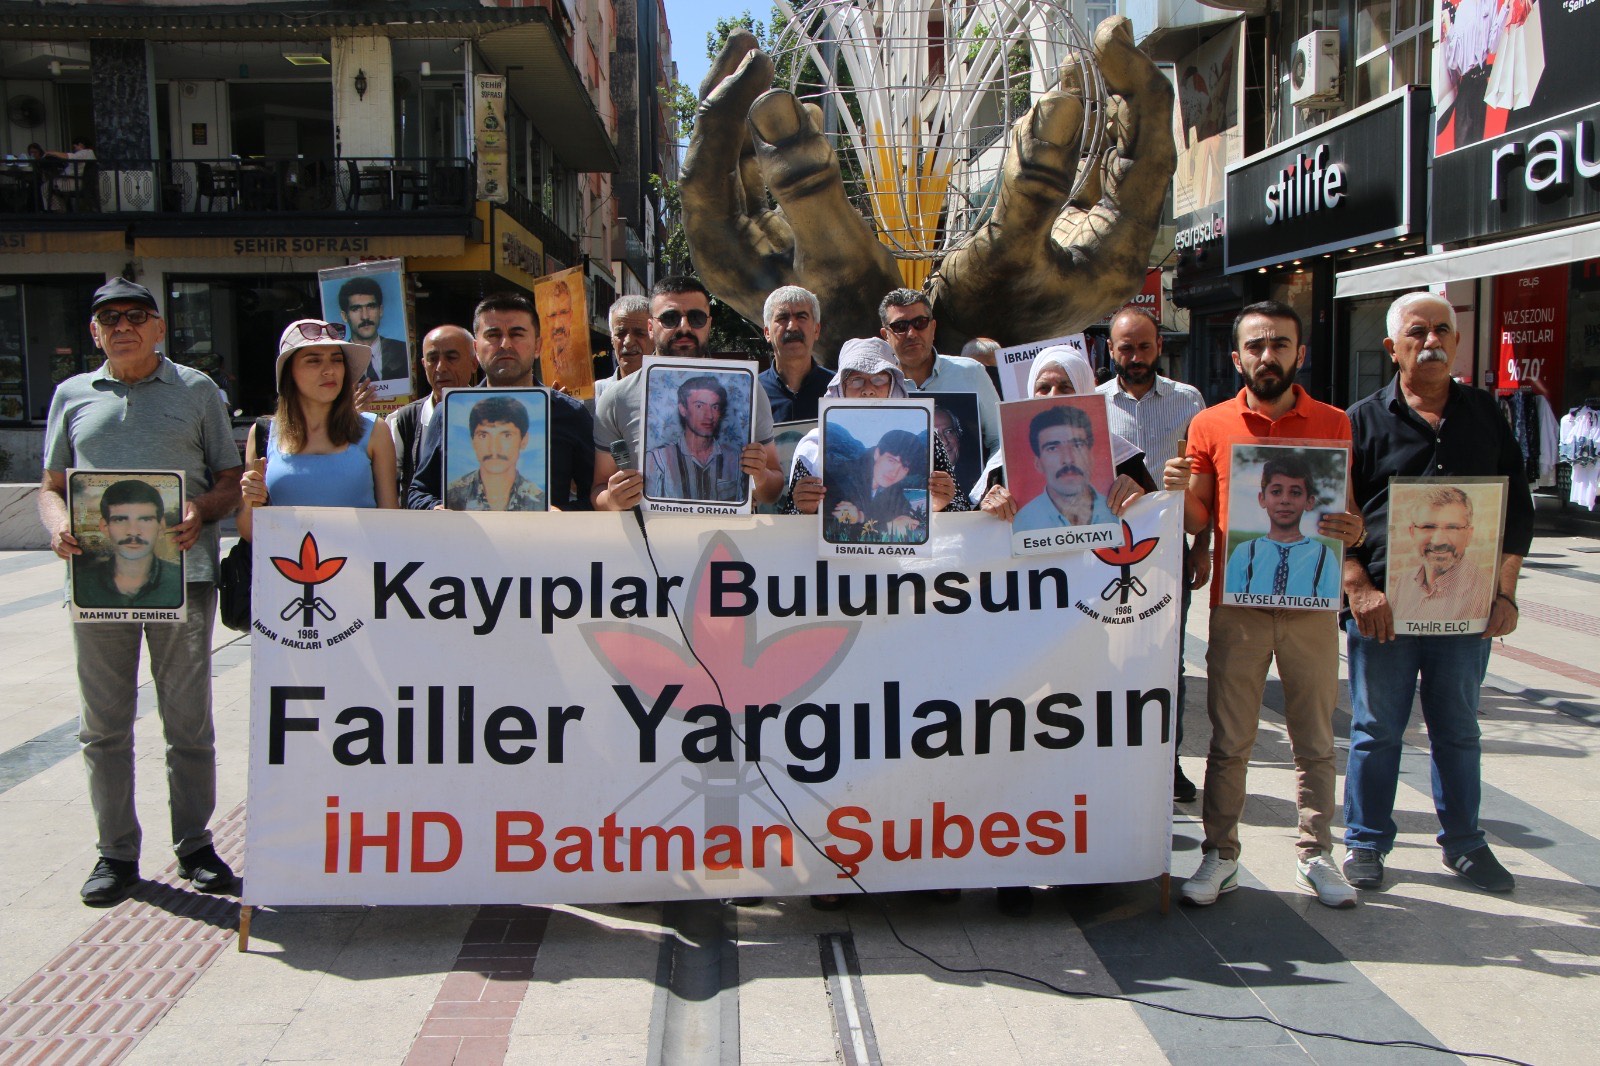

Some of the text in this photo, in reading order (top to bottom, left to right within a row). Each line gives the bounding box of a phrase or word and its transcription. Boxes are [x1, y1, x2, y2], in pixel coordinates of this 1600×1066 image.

[480, 81, 502, 90] ŞEHİR
[481, 91, 503, 99] SOFRASI
[1265, 144, 1342, 226] stilife
[233, 238, 369, 255] ŞEHİR SOFRASI
[1518, 276, 1540, 288] rays
[1503, 308, 1555, 325] YAZ SEZONU
[1502, 329, 1554, 345] FIRSATLARI
[1004, 346, 1047, 365] İBRAHİ
[650, 503, 738, 515] Mehmet ORHAN
[1023, 530, 1113, 549] Eset GÖKTAYI
[835, 544, 916, 556] İSMAİL AĞAYA
[374, 560, 1069, 635] Kayıplar Bulunsun
[1234, 593, 1330, 608] VEYSEL ATILGAN
[80, 610, 180, 620] MAHMUT DEMİREL
[1074, 593, 1173, 625] İNSAN HAKLARI DERNEĞİ
[1115, 605, 1132, 615] 1986
[252, 618, 364, 650] İNSAN HAKLARI DERNEĞİ
[297, 629, 319, 640] 1986
[1406, 620, 1470, 633] TAHİR ELÇİ
[269, 681, 1172, 784] Failler Yargılansın
[324, 794, 1088, 878] İHD Batman Şubesi
